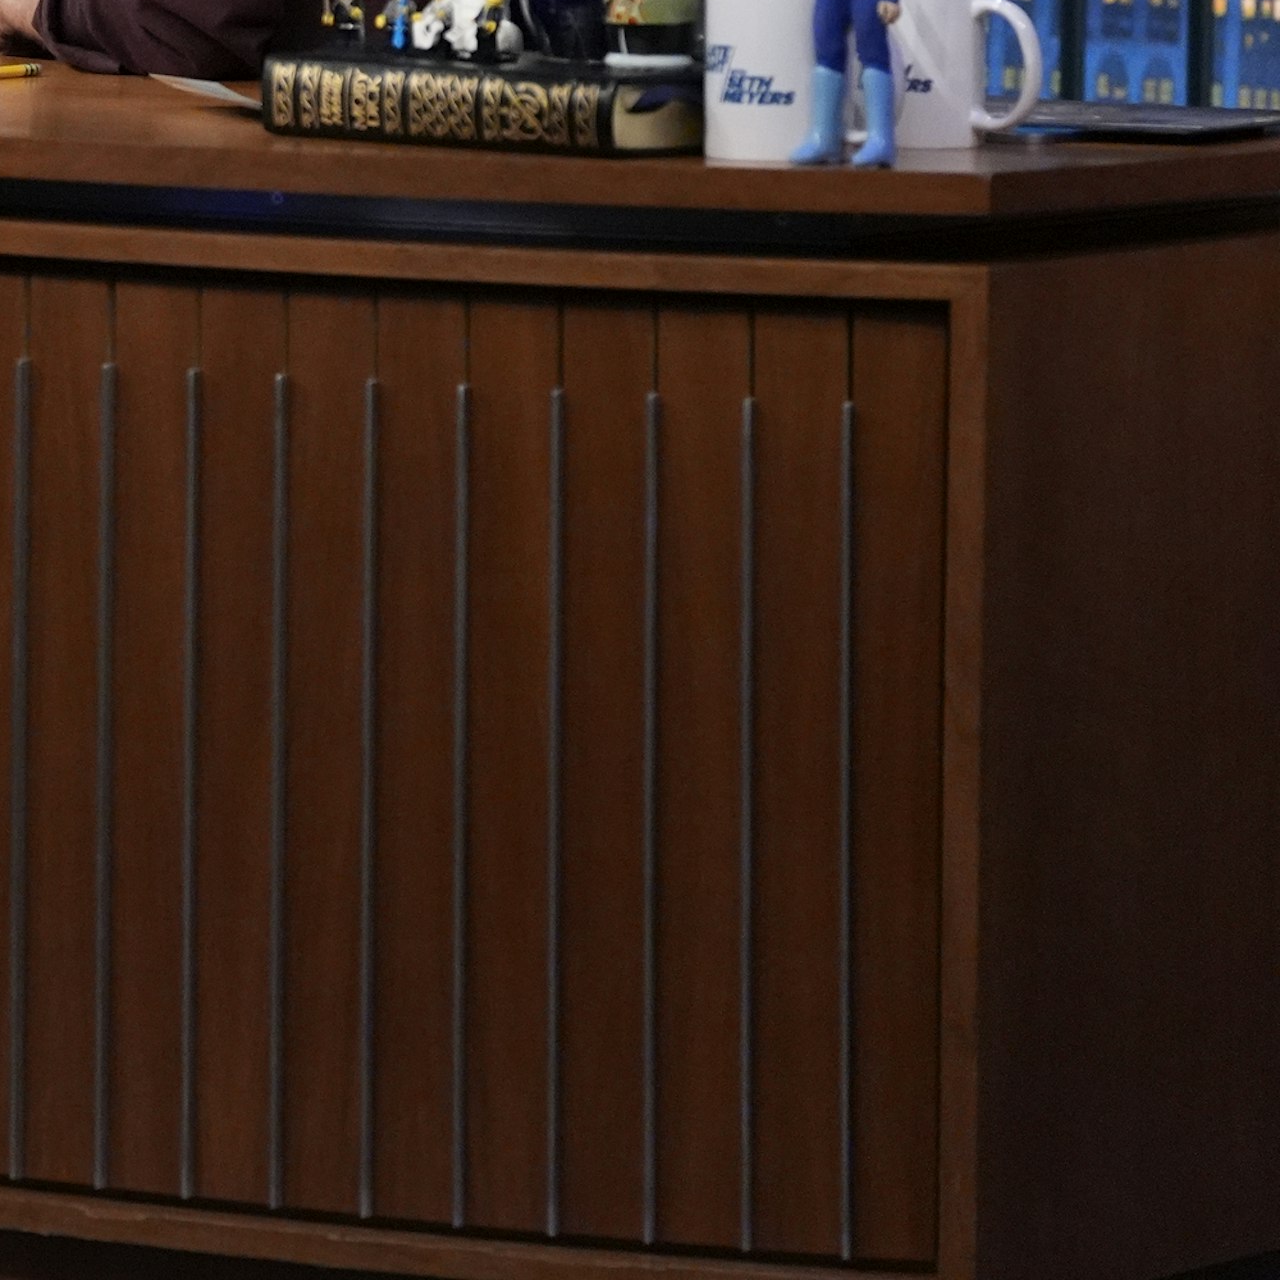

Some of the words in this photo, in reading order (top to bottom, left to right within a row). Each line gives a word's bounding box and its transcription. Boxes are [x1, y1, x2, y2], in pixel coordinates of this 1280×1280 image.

[351, 68, 370, 131] MOBY
[722, 90, 795, 105] MEYERS
[727, 76, 774, 91] SETH
[366, 75, 382, 128] DICK
